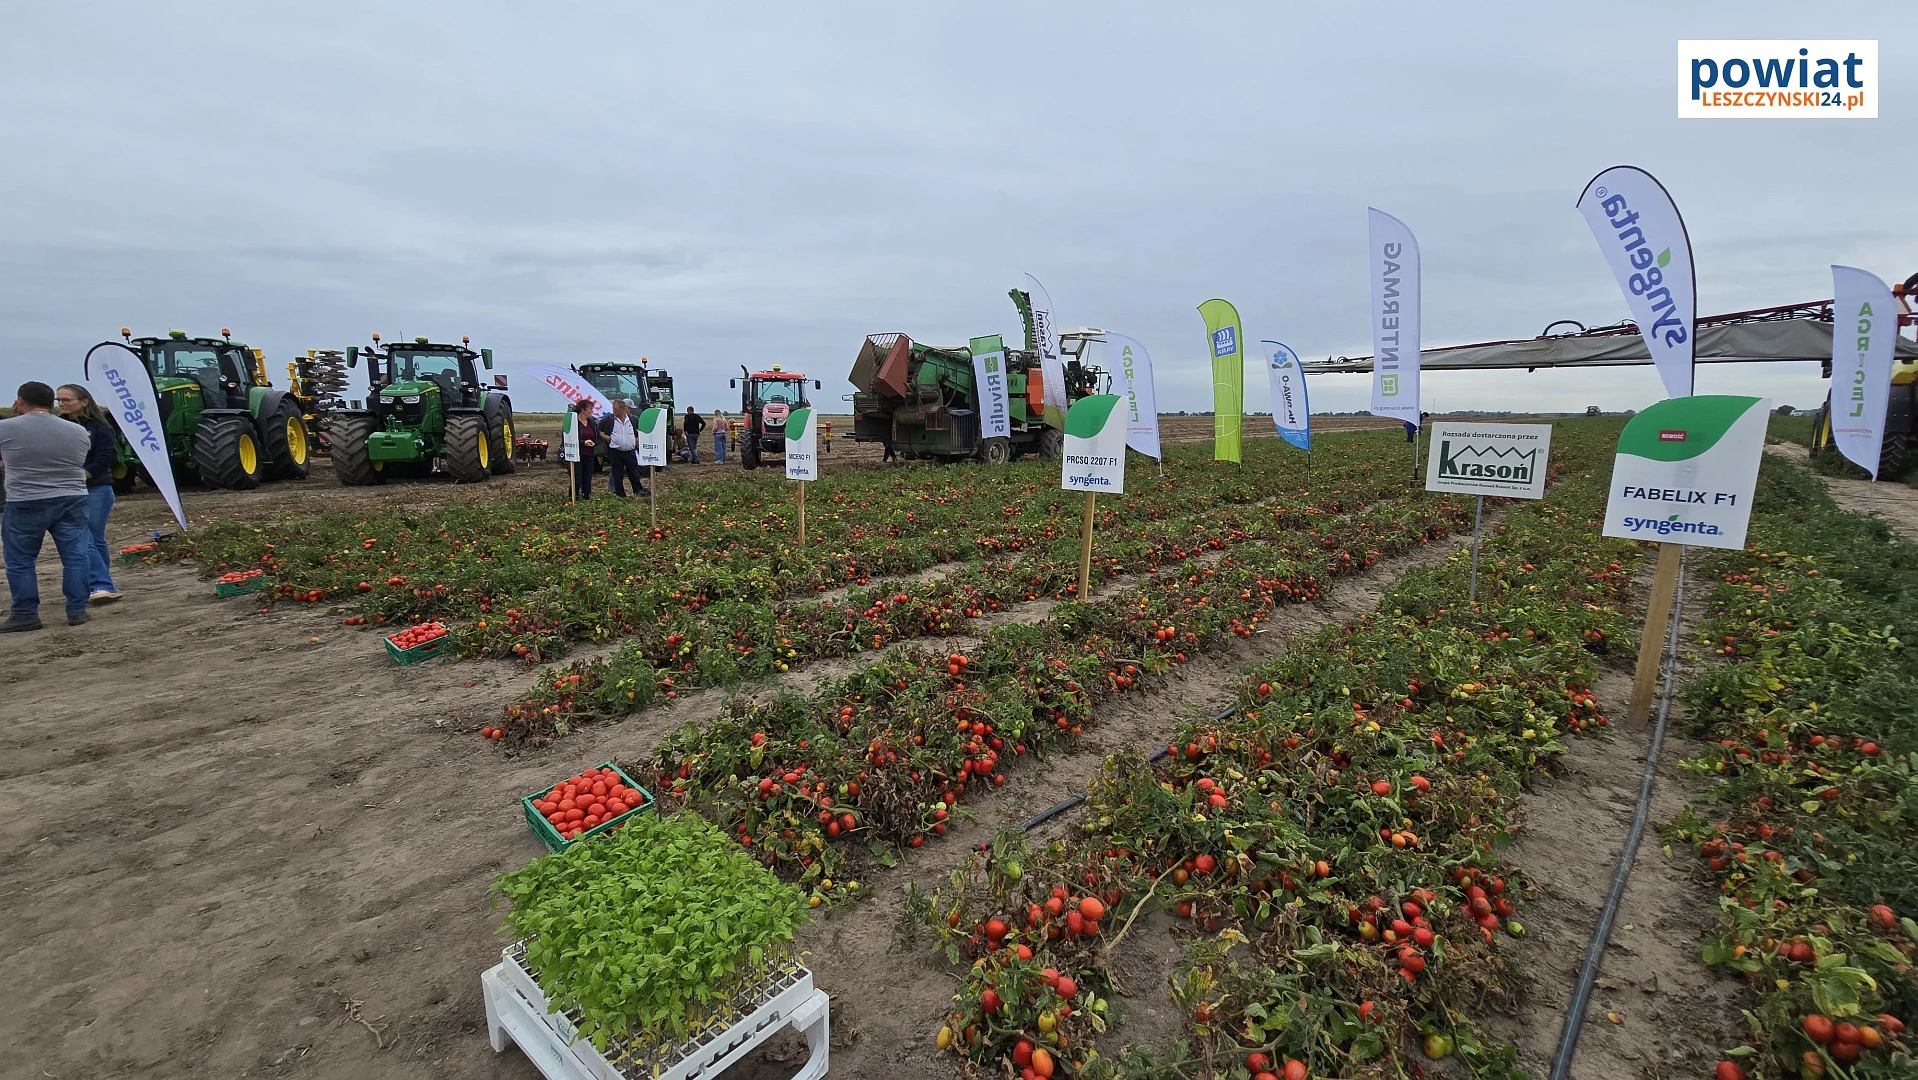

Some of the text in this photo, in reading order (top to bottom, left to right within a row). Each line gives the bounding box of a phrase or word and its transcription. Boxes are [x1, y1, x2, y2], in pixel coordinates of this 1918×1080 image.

[1442, 430, 1539, 441] Rozsada dostarczona przez
[1066, 455, 1118, 467] PRCSQ 2207 F1
[1069, 475, 1109, 487] syngenta
[1623, 486, 1737, 506] FABELIX F1
[1623, 516, 1720, 536] syngenta
